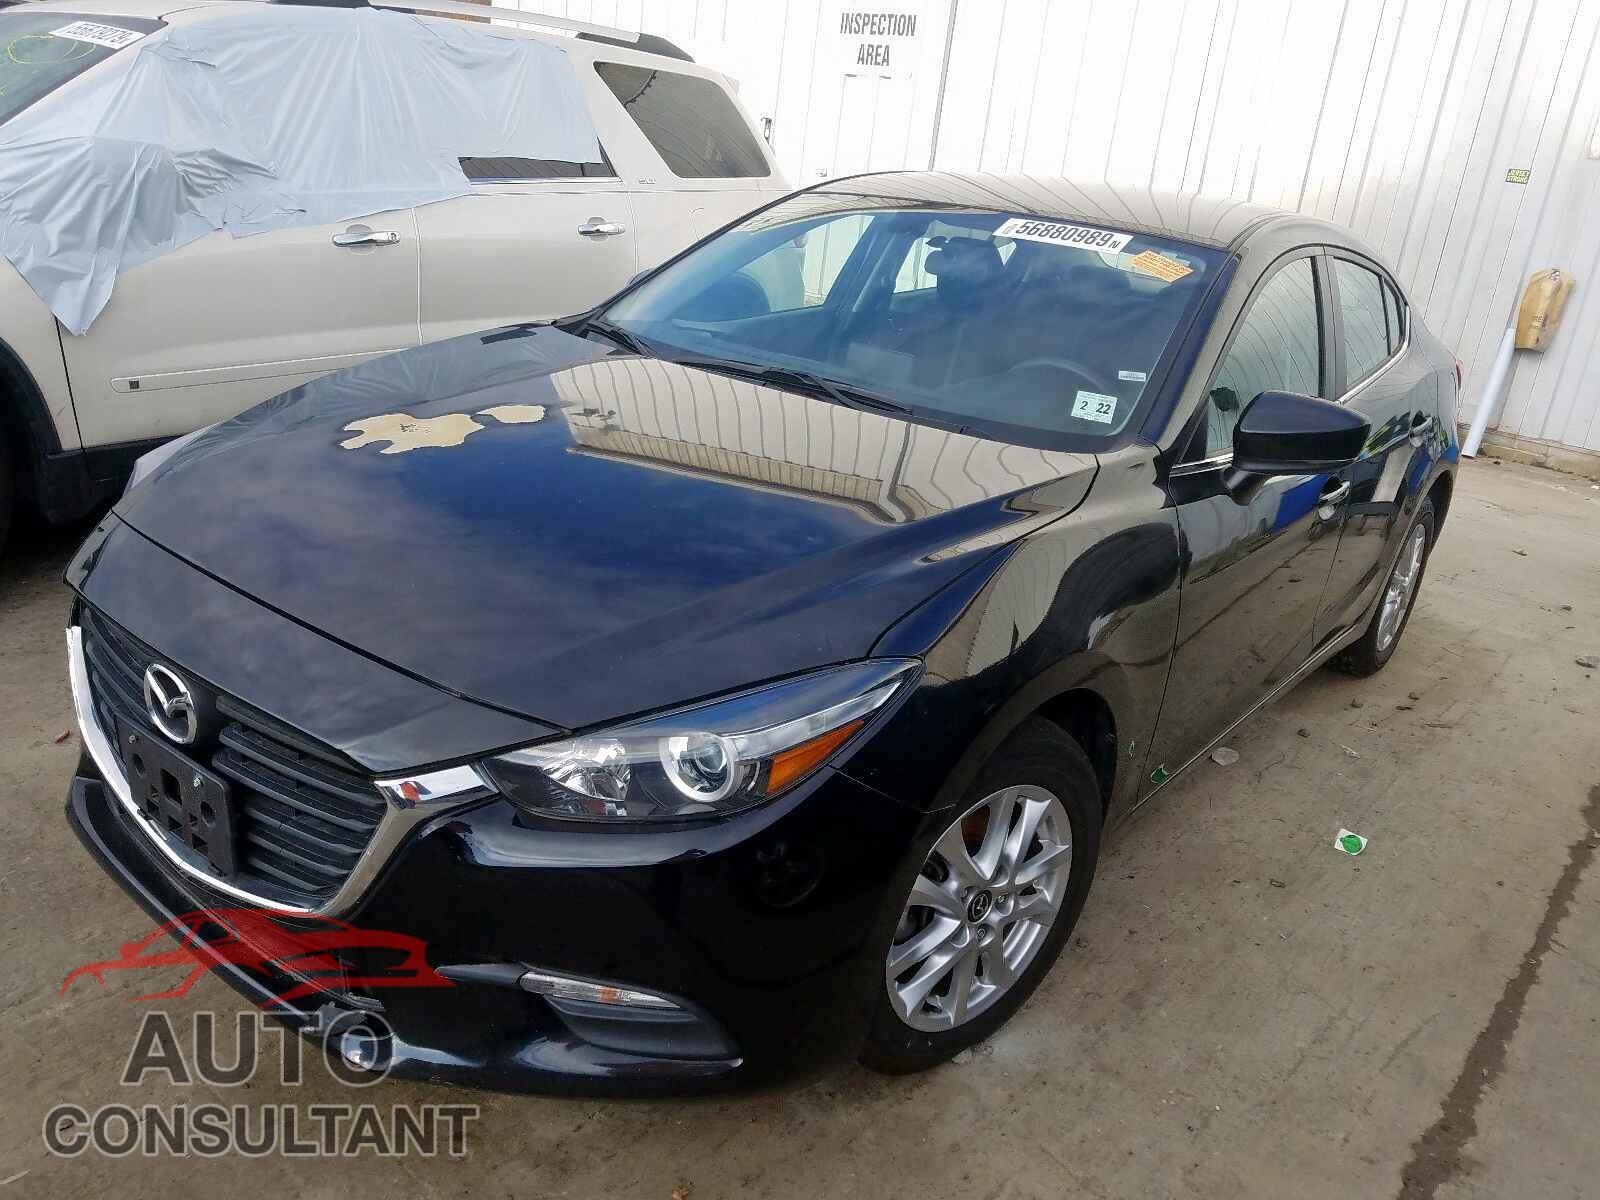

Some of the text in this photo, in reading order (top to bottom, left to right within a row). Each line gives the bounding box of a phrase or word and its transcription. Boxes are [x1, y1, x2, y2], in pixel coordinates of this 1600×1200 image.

[840, 12, 917, 36] INSPECTION
[857, 43, 890, 66] AREA
[1016, 221, 1114, 247] 56880989
[1080, 400, 1112, 415] 2 22
